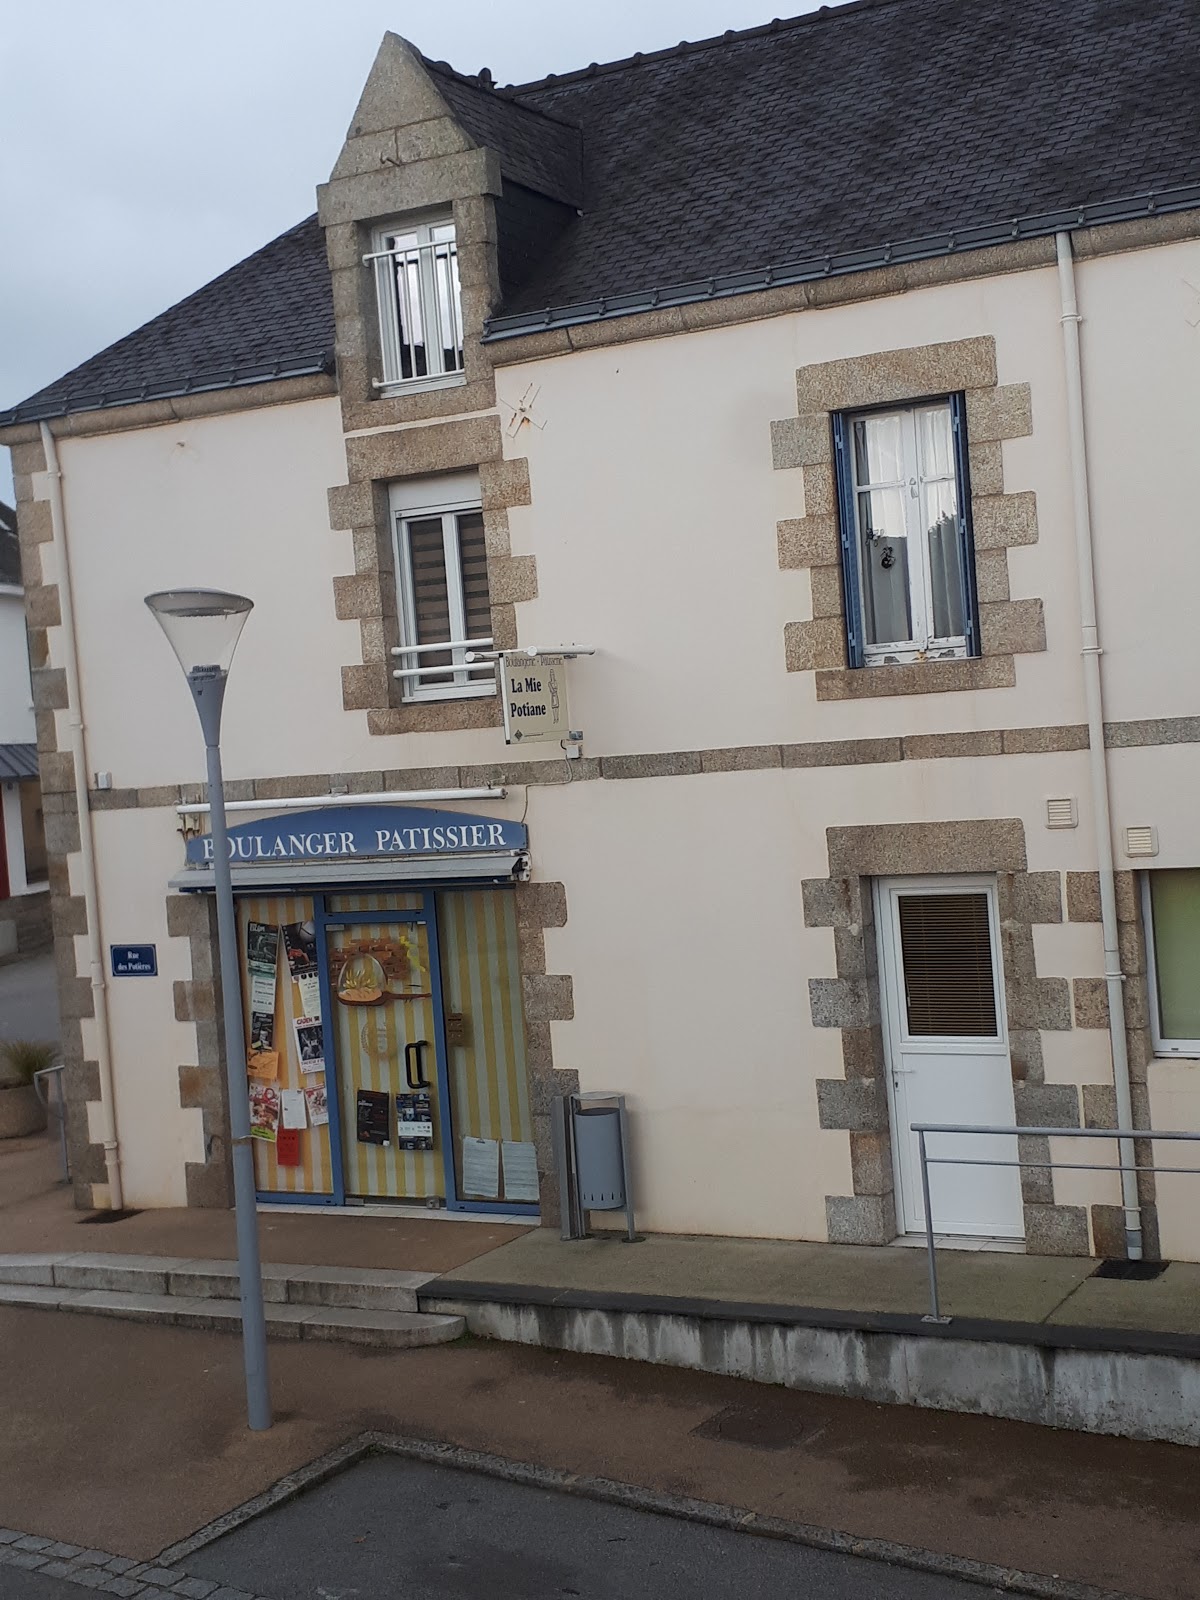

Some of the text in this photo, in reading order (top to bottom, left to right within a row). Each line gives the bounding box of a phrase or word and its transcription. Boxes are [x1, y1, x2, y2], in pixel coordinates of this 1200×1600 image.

[511, 677, 542, 693] La Mie
[510, 702, 547, 718] Potiane
[375, 823, 506, 851] PATISSIER
[127, 951, 140, 960] Rue
[117, 962, 128, 971] des
